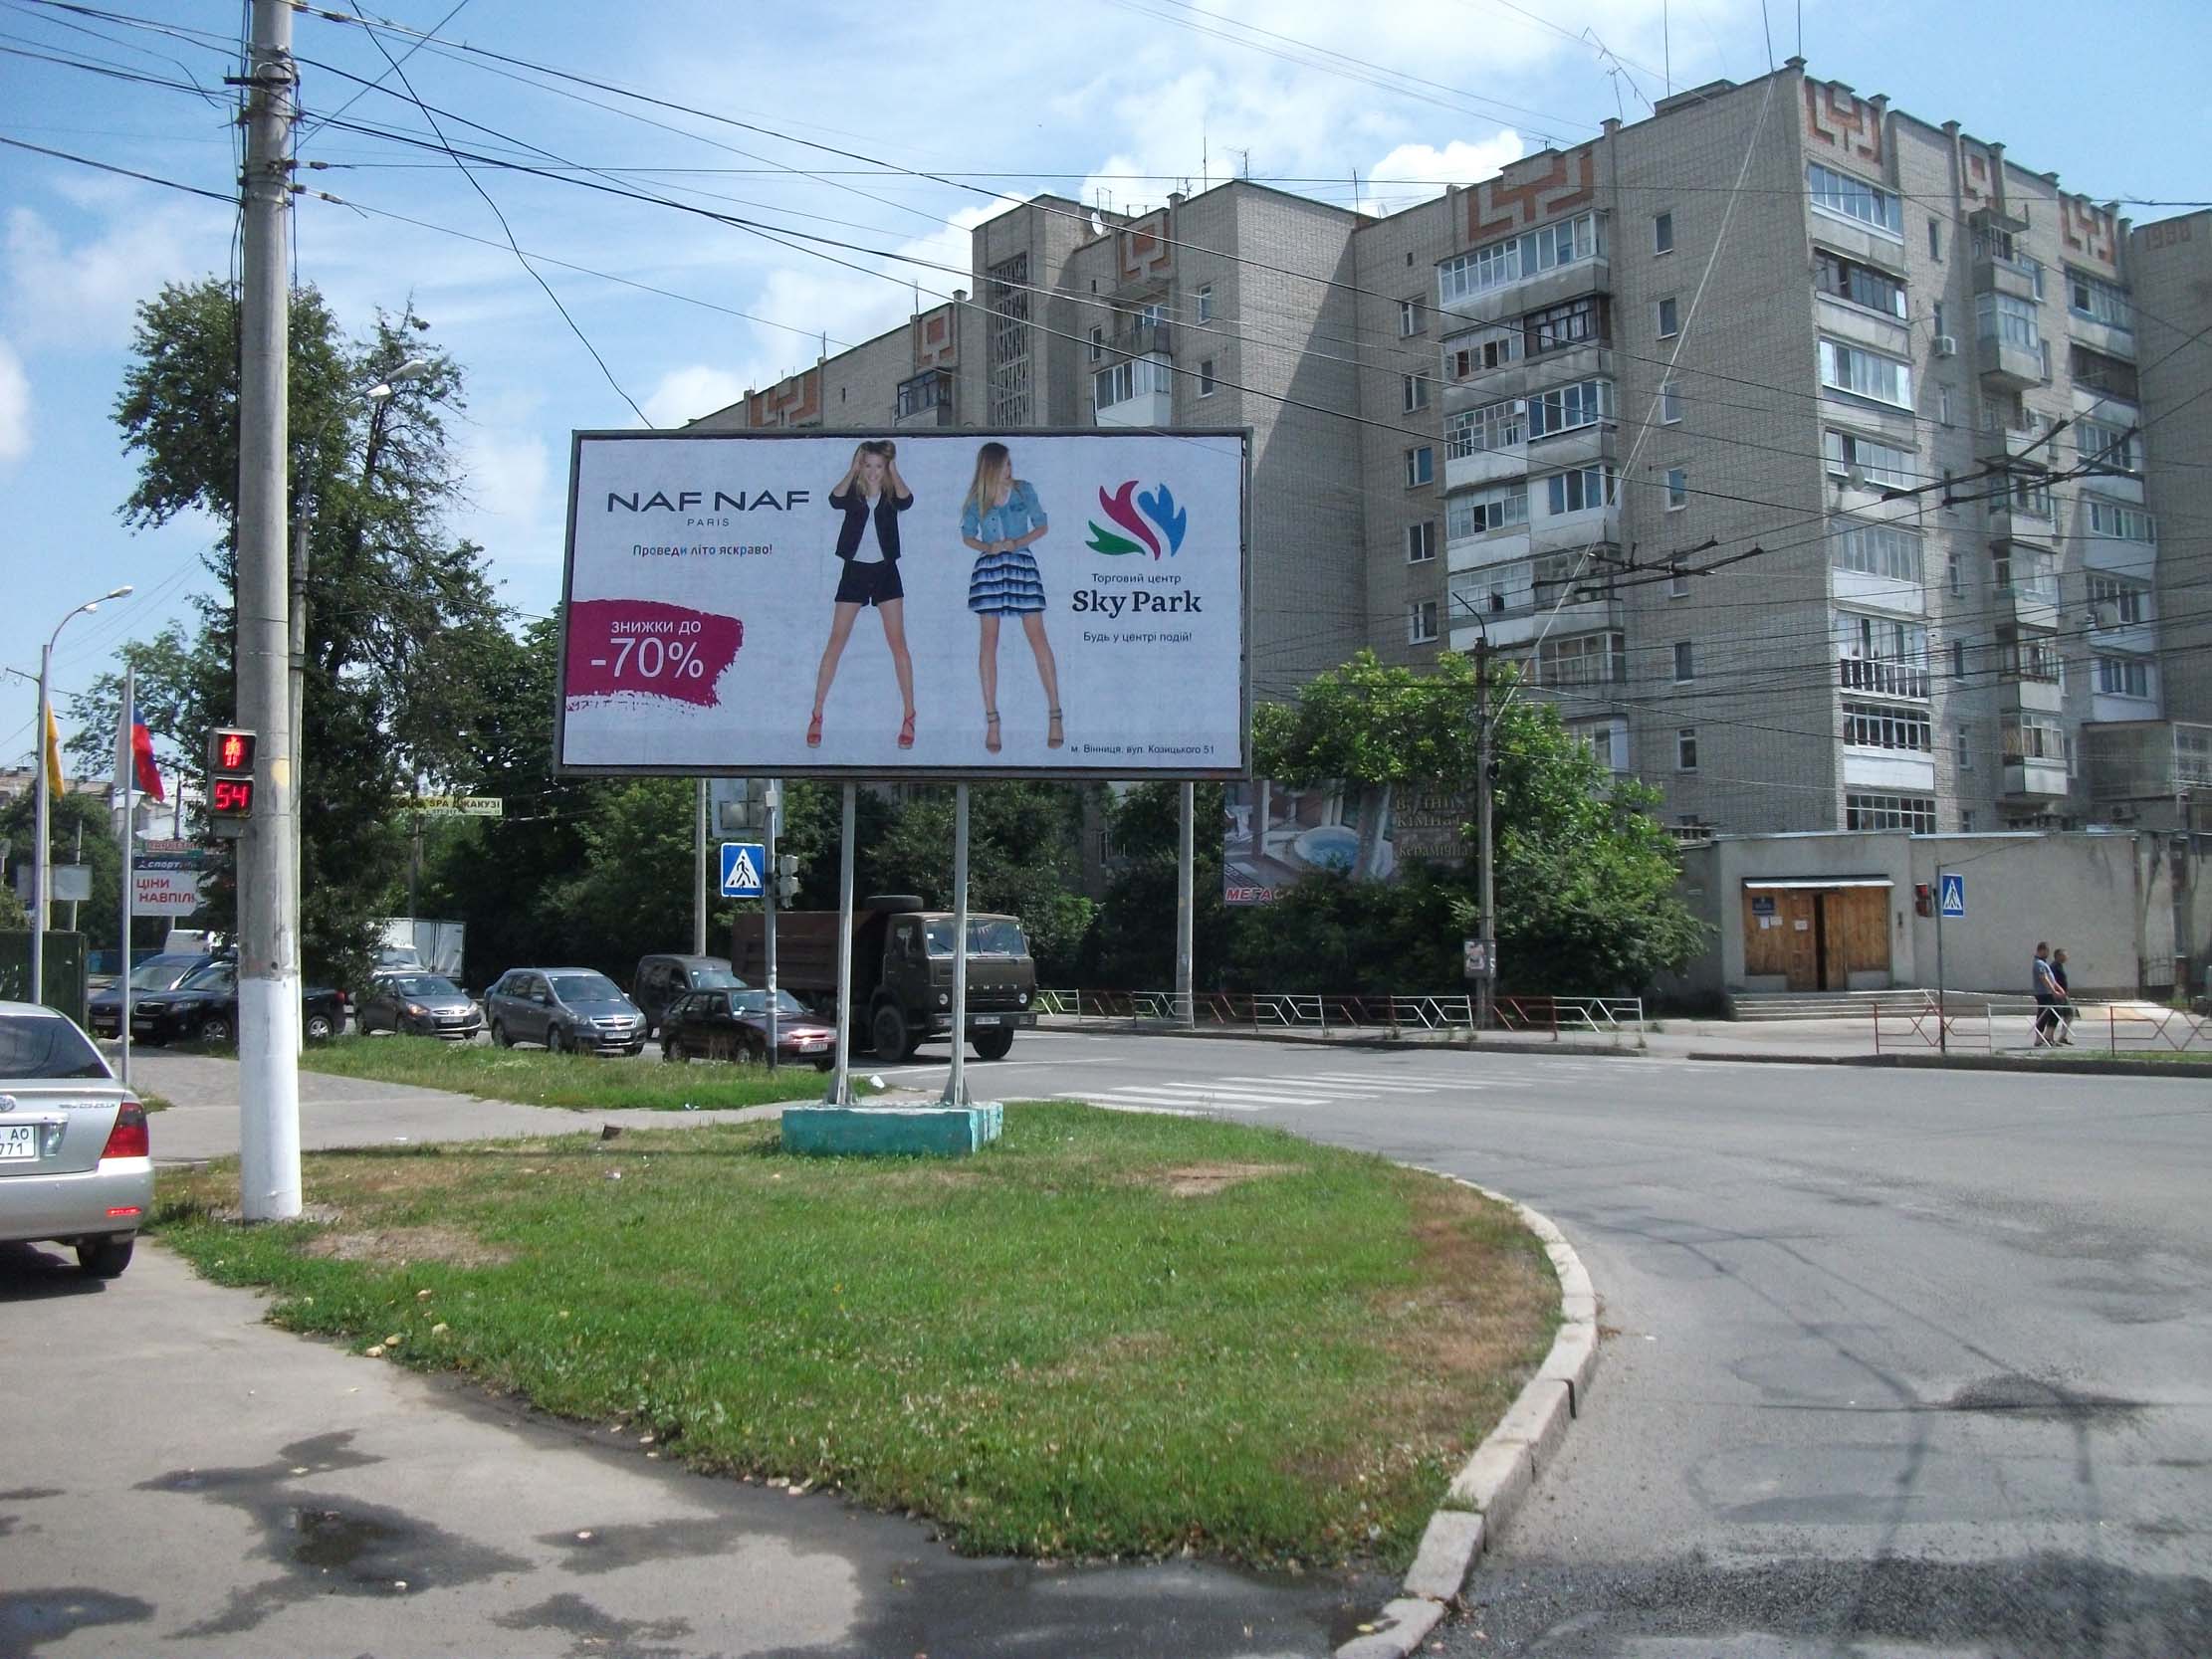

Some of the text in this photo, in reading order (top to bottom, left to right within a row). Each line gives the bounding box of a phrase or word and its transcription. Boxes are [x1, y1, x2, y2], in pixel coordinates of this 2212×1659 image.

[607, 490, 809, 512] NAF NAF
[687, 518, 730, 526] PARIS
[633, 543, 773, 557] Проведи літо яскраво!
[1091, 573, 1182, 585] Торговий центр
[1072, 589, 1203, 619] Sky Park
[1083, 631, 1193, 644] Будь у центрі подій!
[590, 637, 704, 679] -70%
[1148, 744, 1202, 754] Козицького
[1204, 744, 1215, 753] 51
[214, 783, 248, 808] 54
[136, 878, 169, 891] ЦІНИ
[10, 1128, 29, 1141] AO
